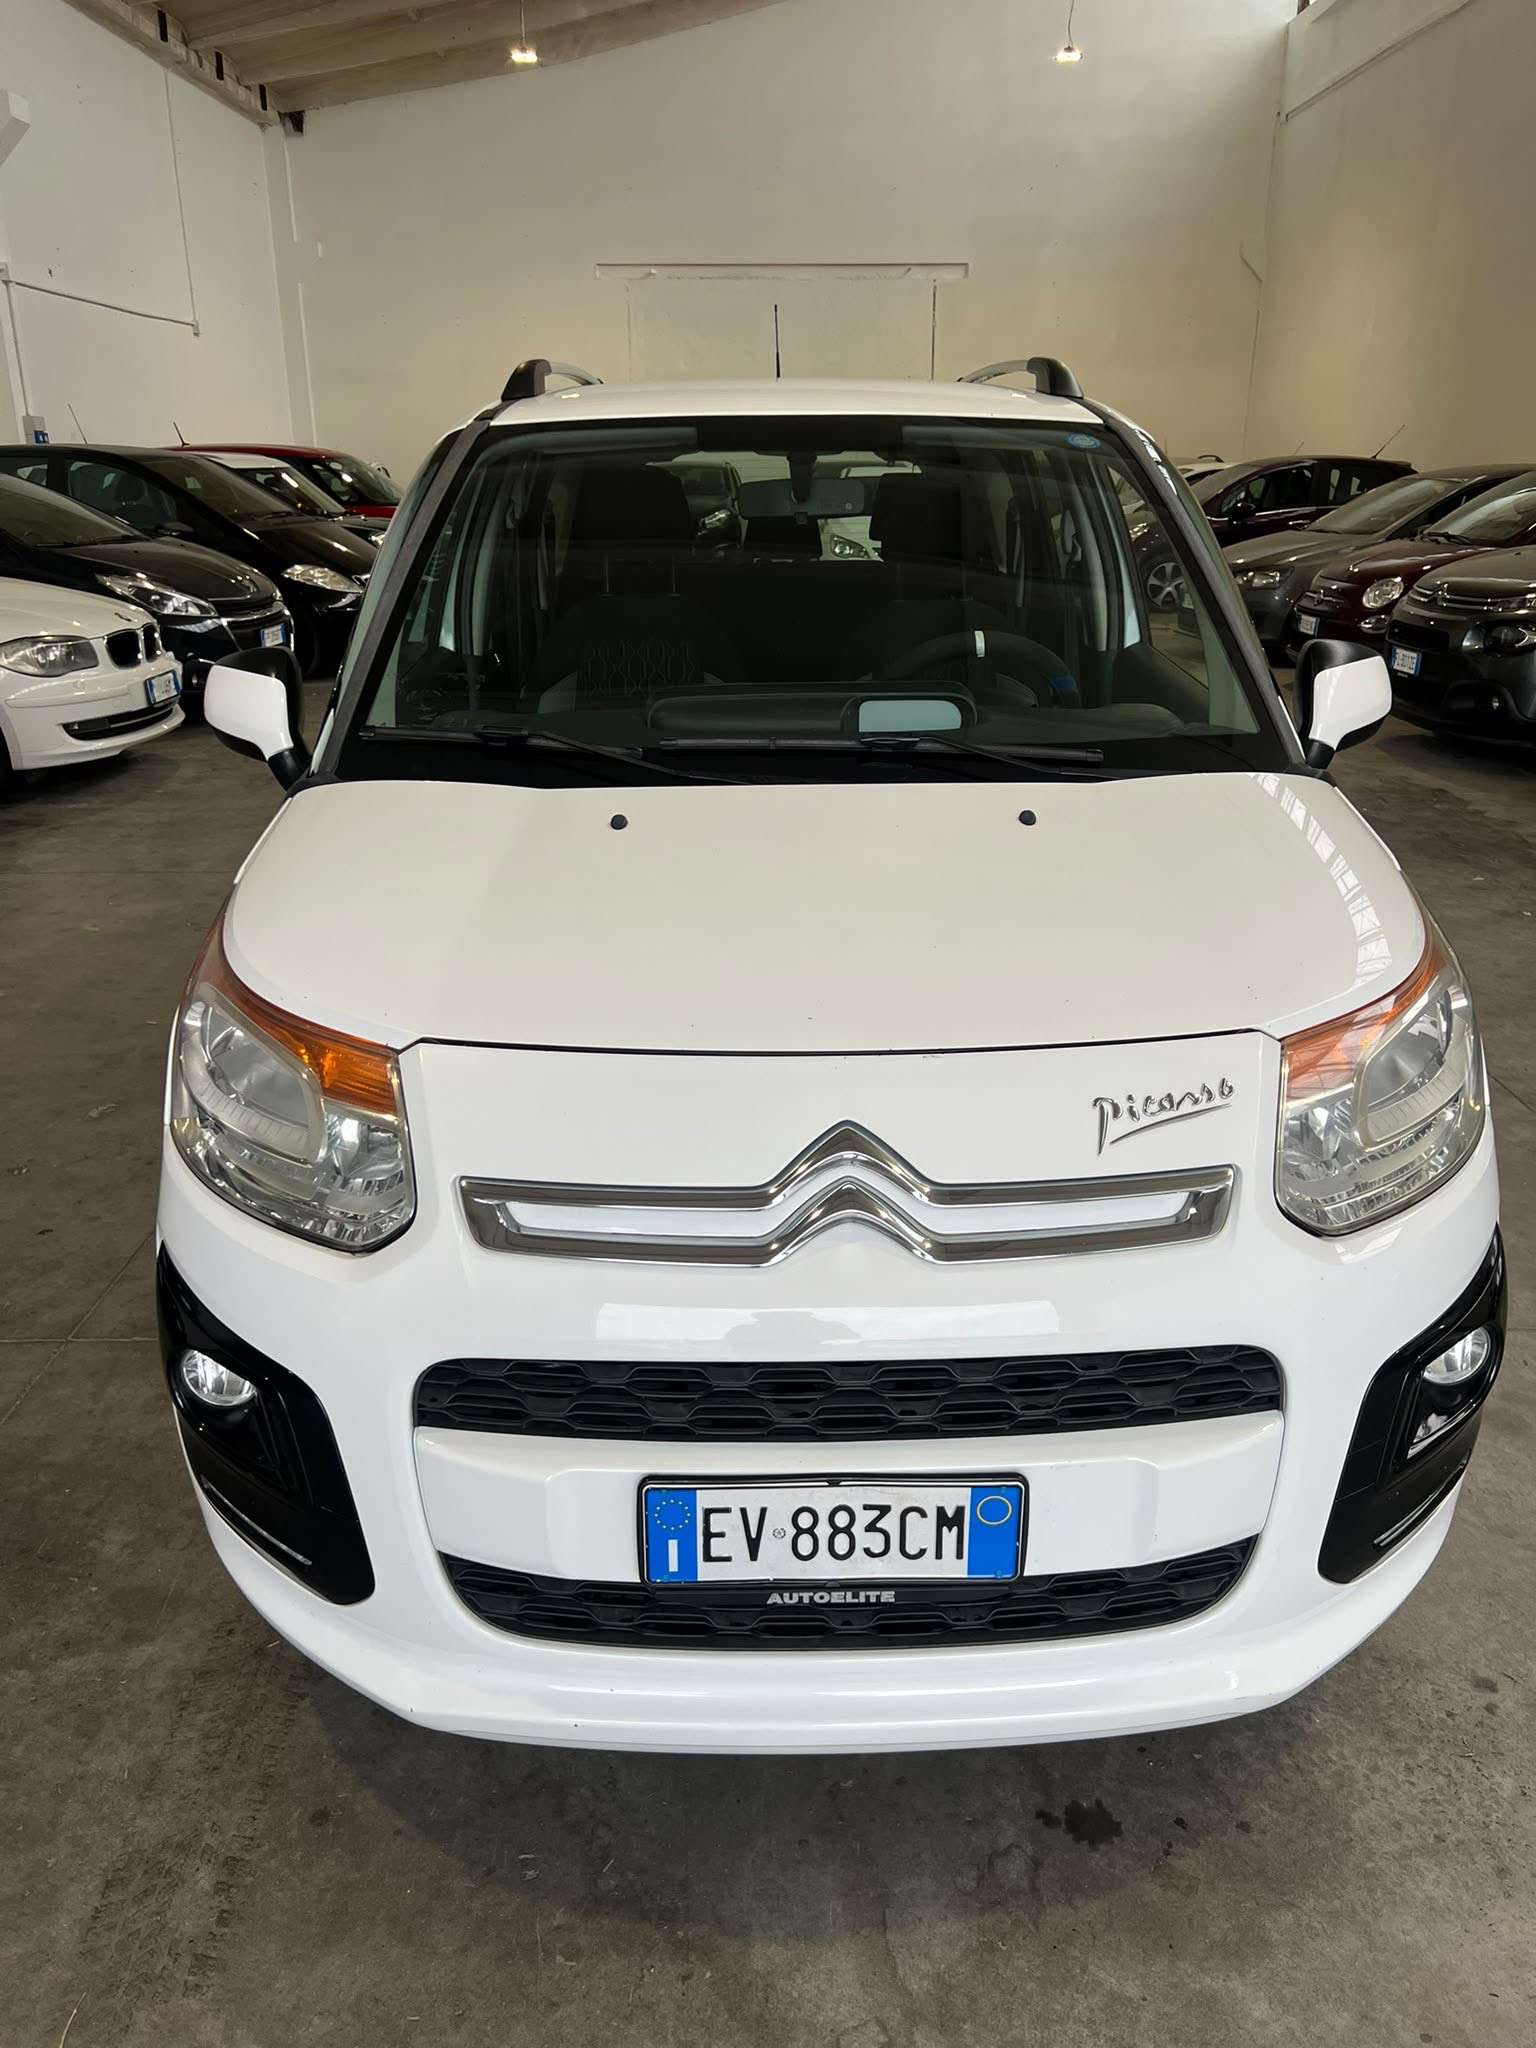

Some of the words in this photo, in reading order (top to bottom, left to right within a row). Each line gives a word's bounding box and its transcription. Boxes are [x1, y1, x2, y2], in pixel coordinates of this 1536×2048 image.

[790, 1503, 966, 1562] 883CM
[667, 1539, 679, 1573] I
[766, 1590, 896, 1605] AUTOELITE
